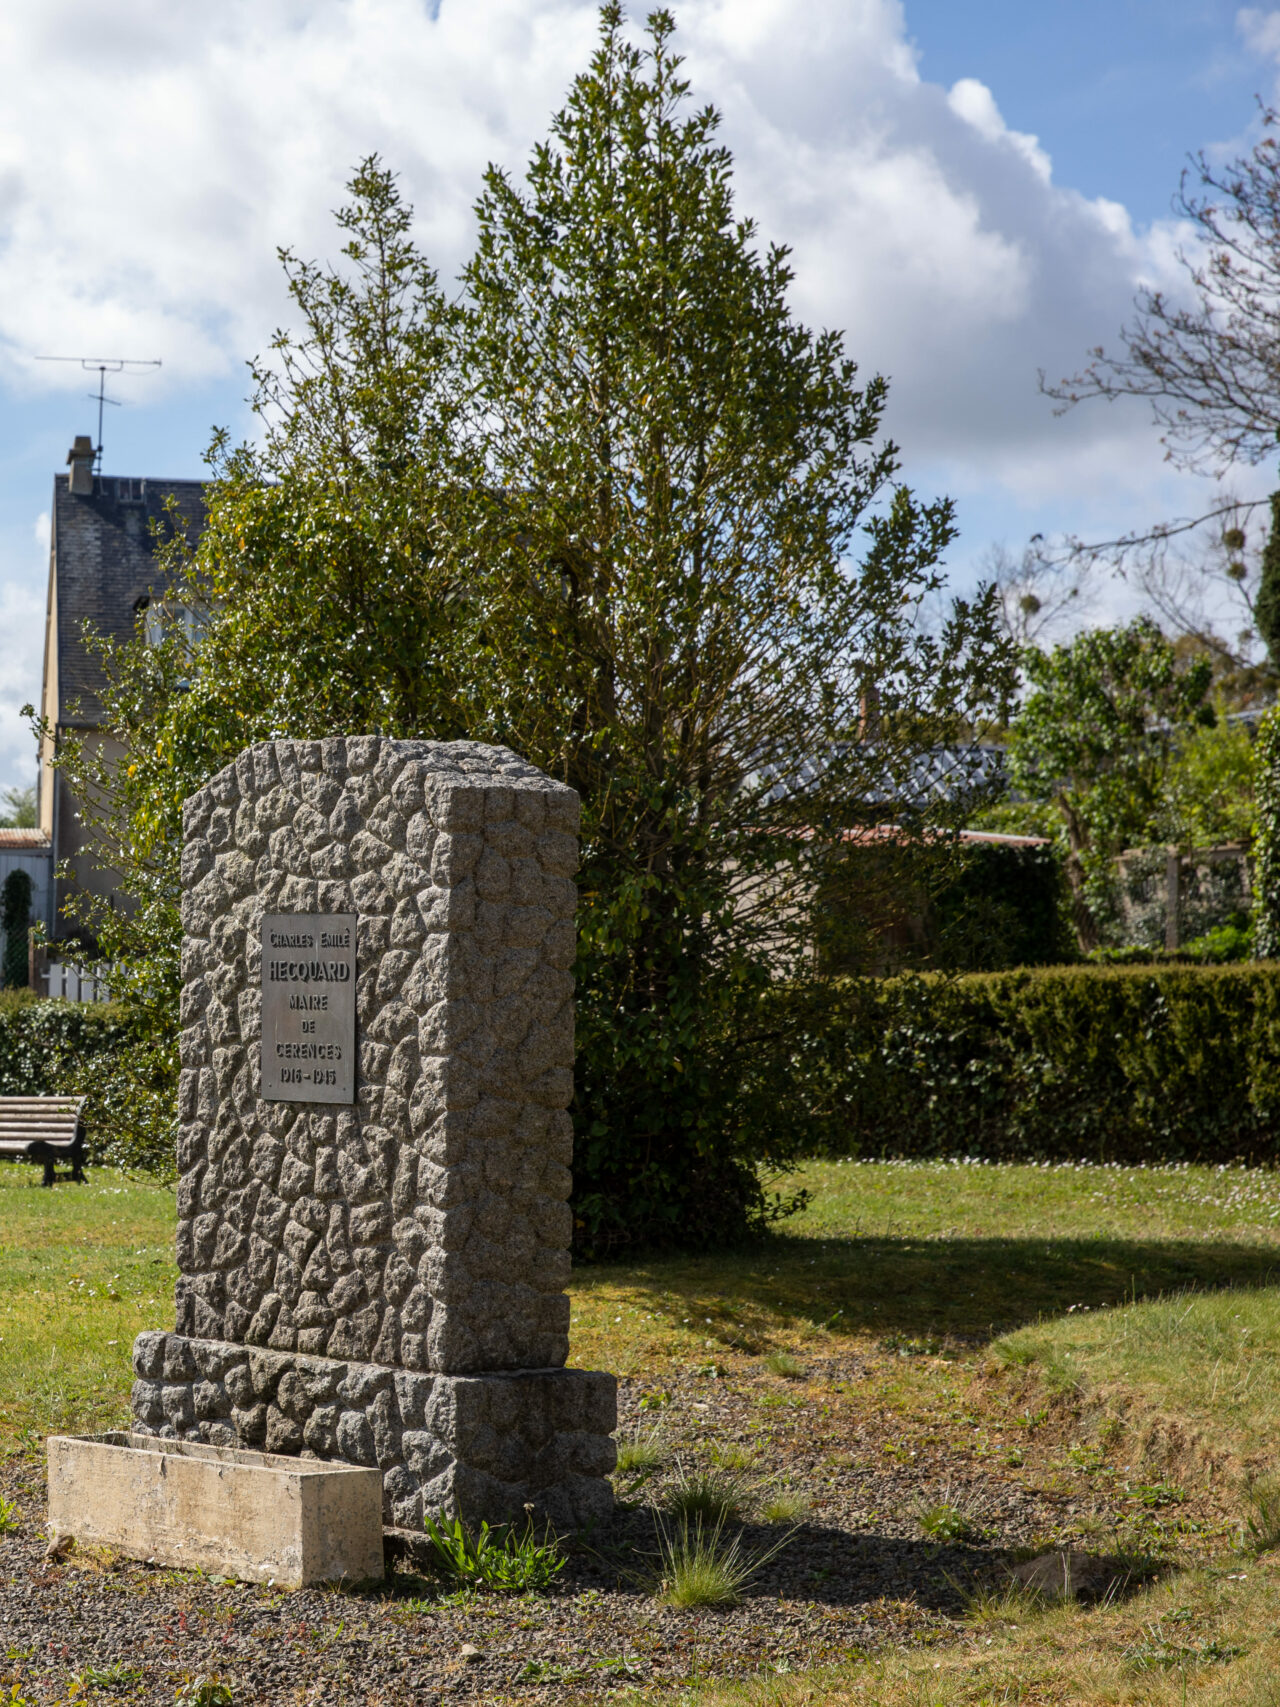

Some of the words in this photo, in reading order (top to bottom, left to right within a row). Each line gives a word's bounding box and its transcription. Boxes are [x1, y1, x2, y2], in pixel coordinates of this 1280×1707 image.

[269, 933, 313, 948] CHARLES
[319, 931, 350, 947] EMILE
[268, 960, 350, 983] HECQUARD
[289, 994, 328, 1010] MAIRE
[301, 1019, 315, 1033] DE
[276, 1042, 342, 1060] CERENCES
